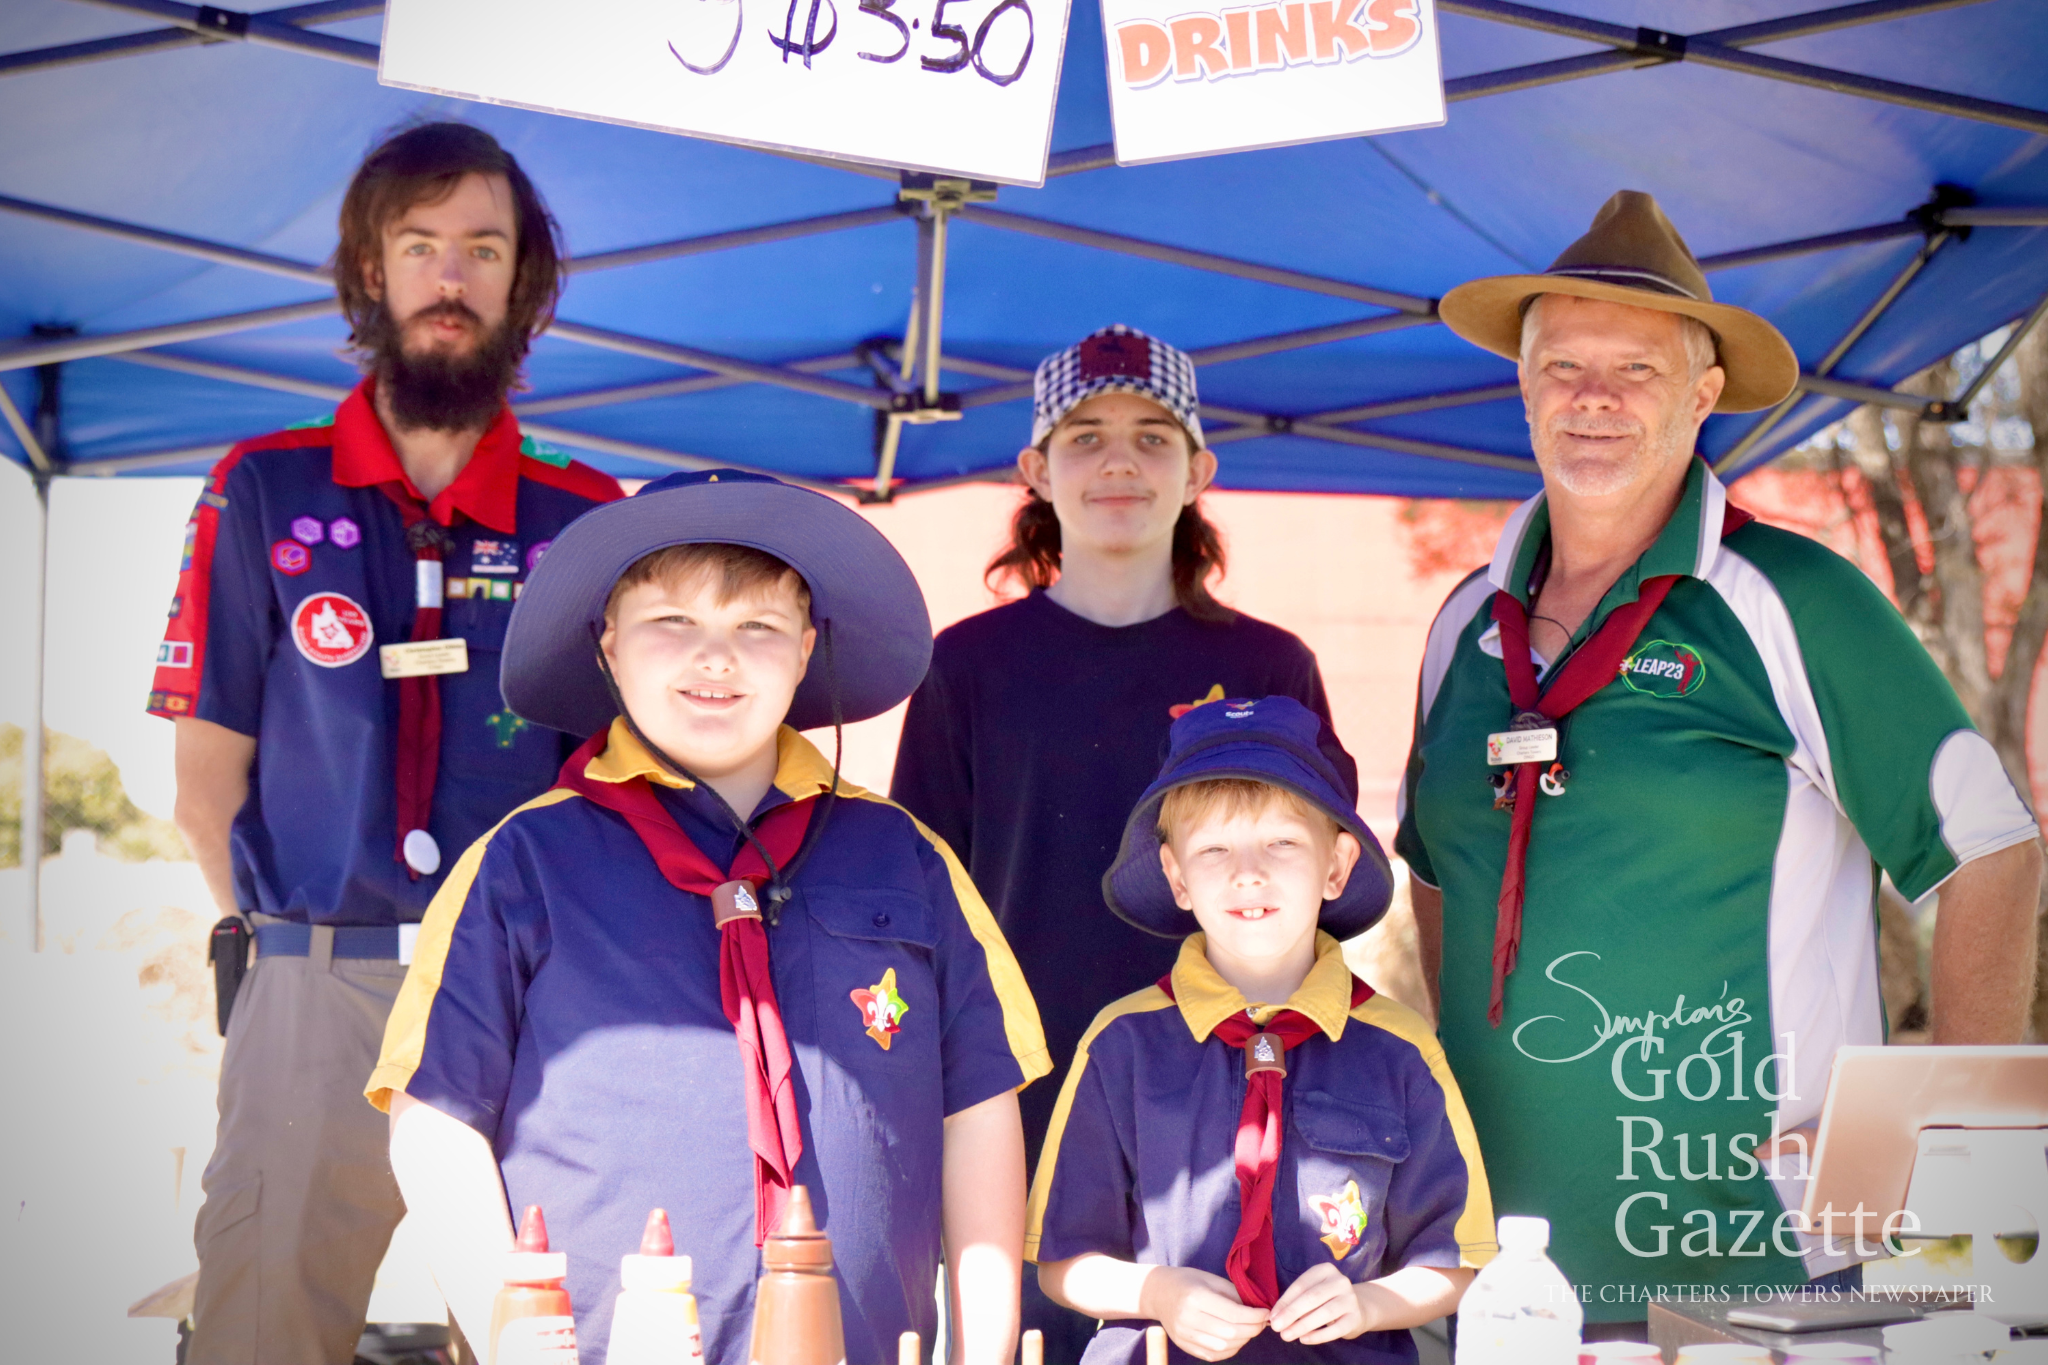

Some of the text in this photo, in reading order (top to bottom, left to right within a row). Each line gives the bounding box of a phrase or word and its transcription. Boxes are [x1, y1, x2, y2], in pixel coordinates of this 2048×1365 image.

[1115, 0, 1421, 88] DRINKS
[1633, 658, 1684, 679] LEAP23
[1225, 710, 1254, 718] Scouts
[1506, 736, 1522, 744] DAVID
